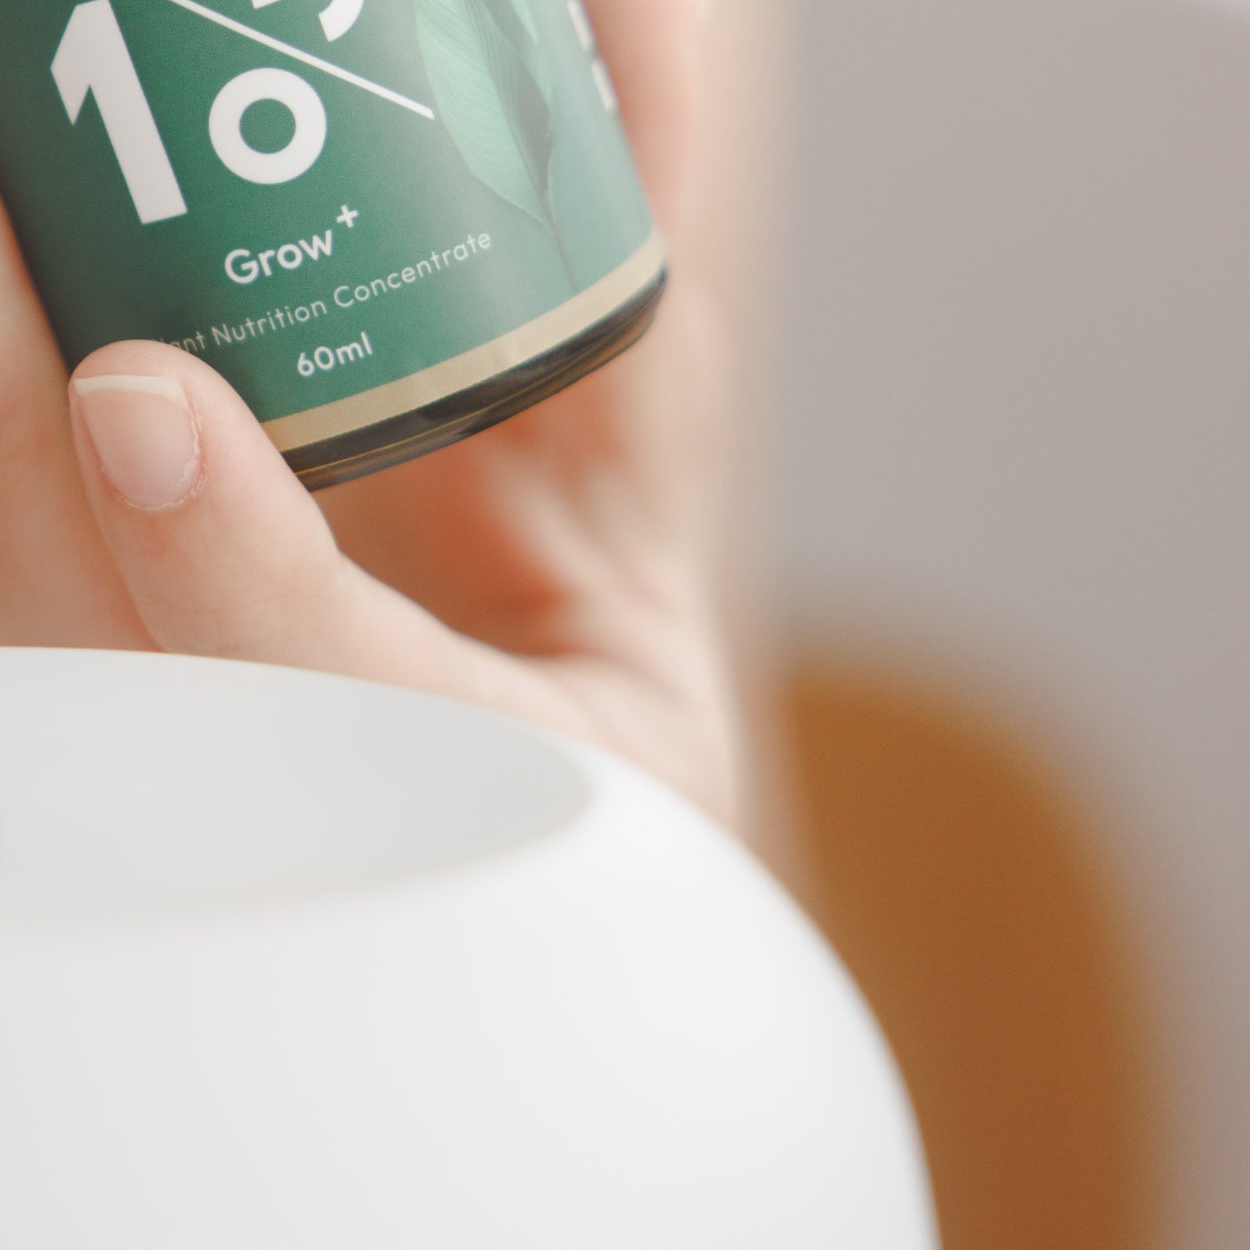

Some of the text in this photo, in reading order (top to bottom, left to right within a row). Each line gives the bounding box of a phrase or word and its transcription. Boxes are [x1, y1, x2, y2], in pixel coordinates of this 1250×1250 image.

[210, 300, 328, 347] Nutrition
[332, 232, 492, 309] Concentrate
[296, 331, 374, 378] 60ml
